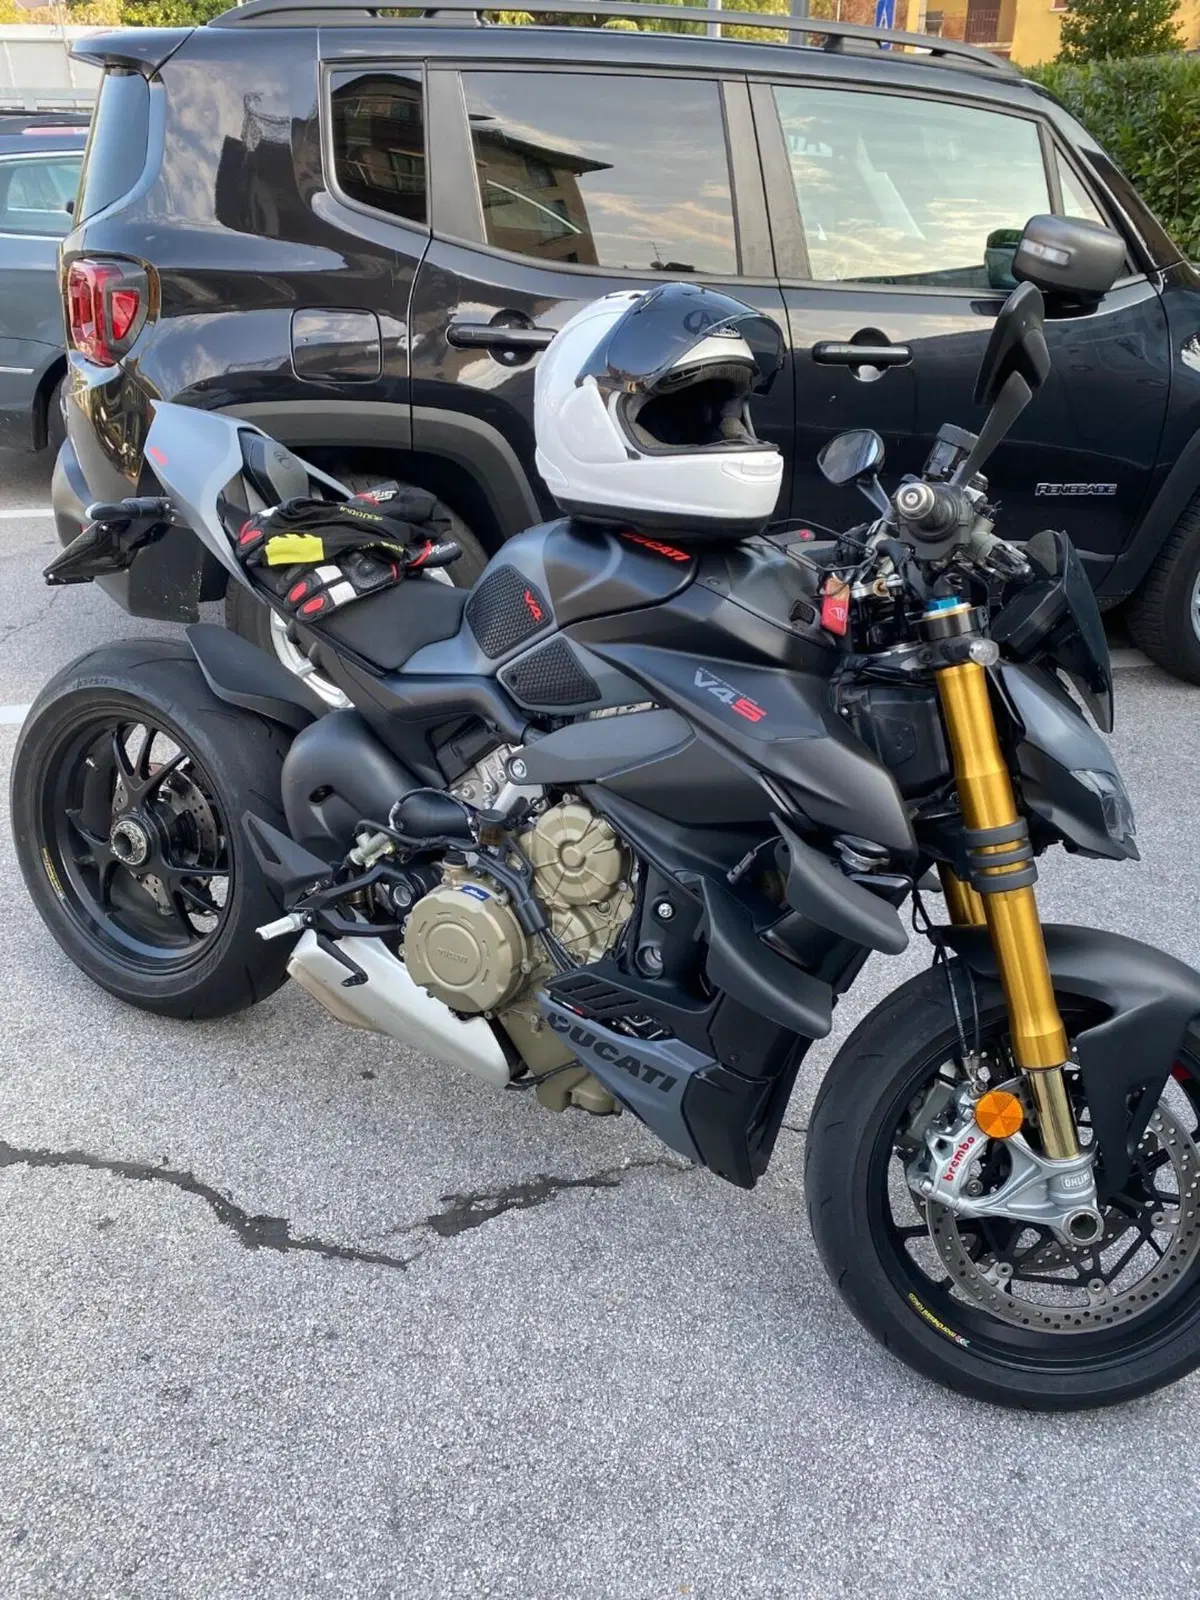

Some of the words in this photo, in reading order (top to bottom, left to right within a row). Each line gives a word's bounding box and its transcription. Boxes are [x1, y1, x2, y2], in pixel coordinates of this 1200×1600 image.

[1034, 483, 1118, 496] RENEGADE
[523, 590, 542, 621] V4
[694, 669, 767, 722] V4S
[546, 1011, 678, 1093] DUCATI
[942, 1136, 975, 1182] brembo
